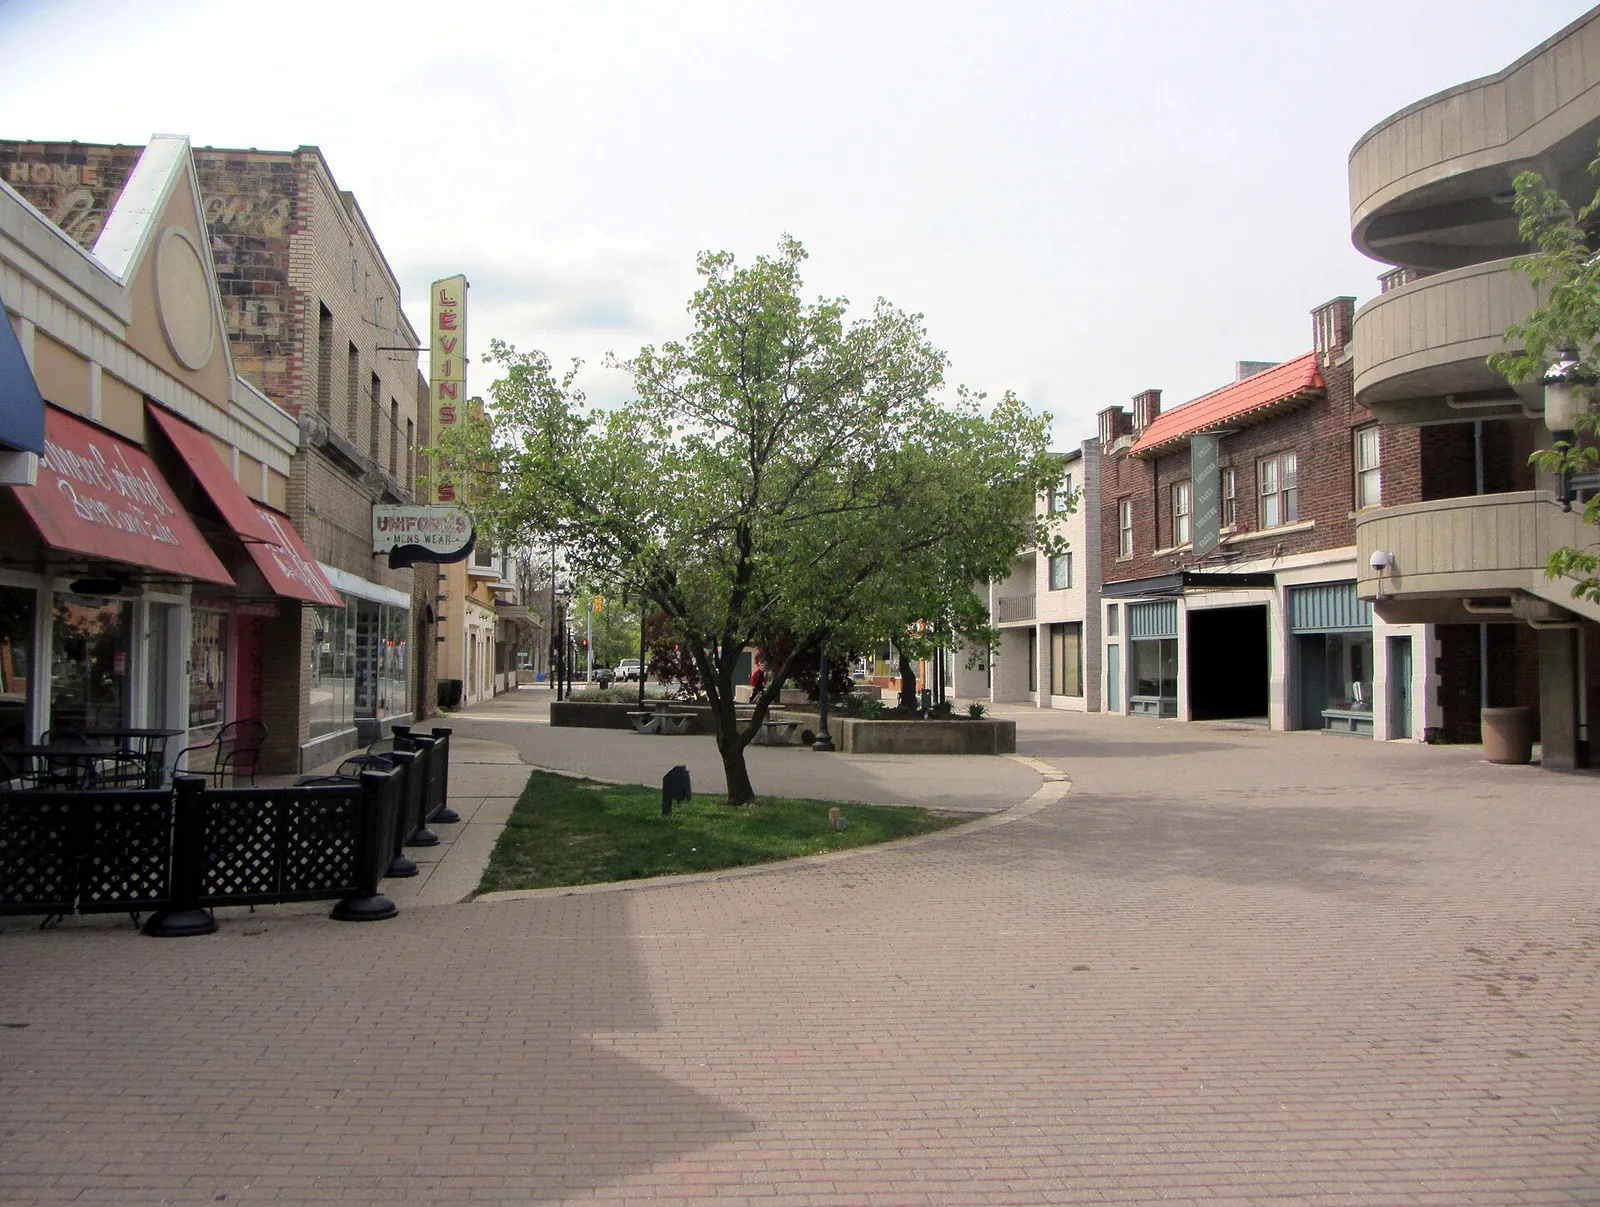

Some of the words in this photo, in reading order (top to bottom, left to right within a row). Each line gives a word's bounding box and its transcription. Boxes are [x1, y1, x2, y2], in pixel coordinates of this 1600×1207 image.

[1198, 441, 1213, 458] FALLS
[1195, 462, 1217, 484] THEATRE
[1199, 487, 1214, 504] FALLS
[377, 516, 467, 533] UNIFORMS
[1195, 506, 1217, 529] THEATRE
[424, 534, 451, 545] WEAR
[1199, 531, 1215, 548] FALLS
